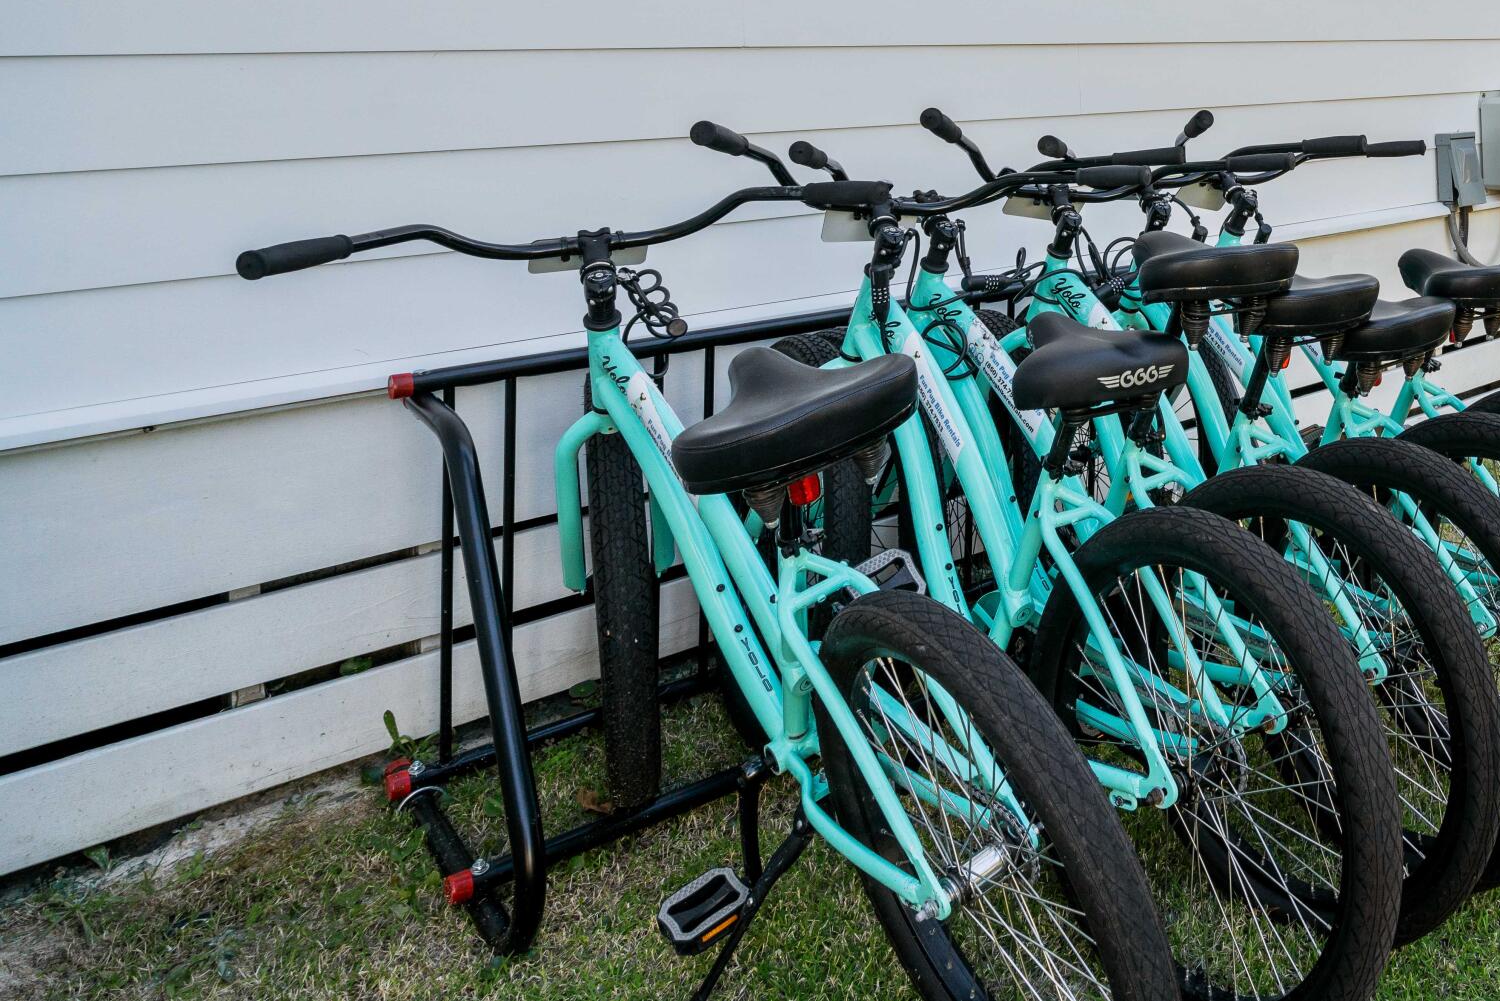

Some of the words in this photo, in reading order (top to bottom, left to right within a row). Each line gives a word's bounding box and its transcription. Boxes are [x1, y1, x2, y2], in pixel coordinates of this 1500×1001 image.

[1050, 277, 1086, 309] Yolo
[989, 352, 1000, 368] Fun
[998, 365, 1010, 381] Pug
[1224, 343, 1243, 367] Rentals
[919, 375, 929, 391] Fun
[926, 388, 936, 406] Pug
[933, 400, 946, 424] Bike
[943, 420, 961, 448] Rentals
[647, 418, 658, 436] Fun
[657, 433, 667, 451] Pug
[948, 576, 965, 616] YOL
[741, 637, 774, 693] YOLO
